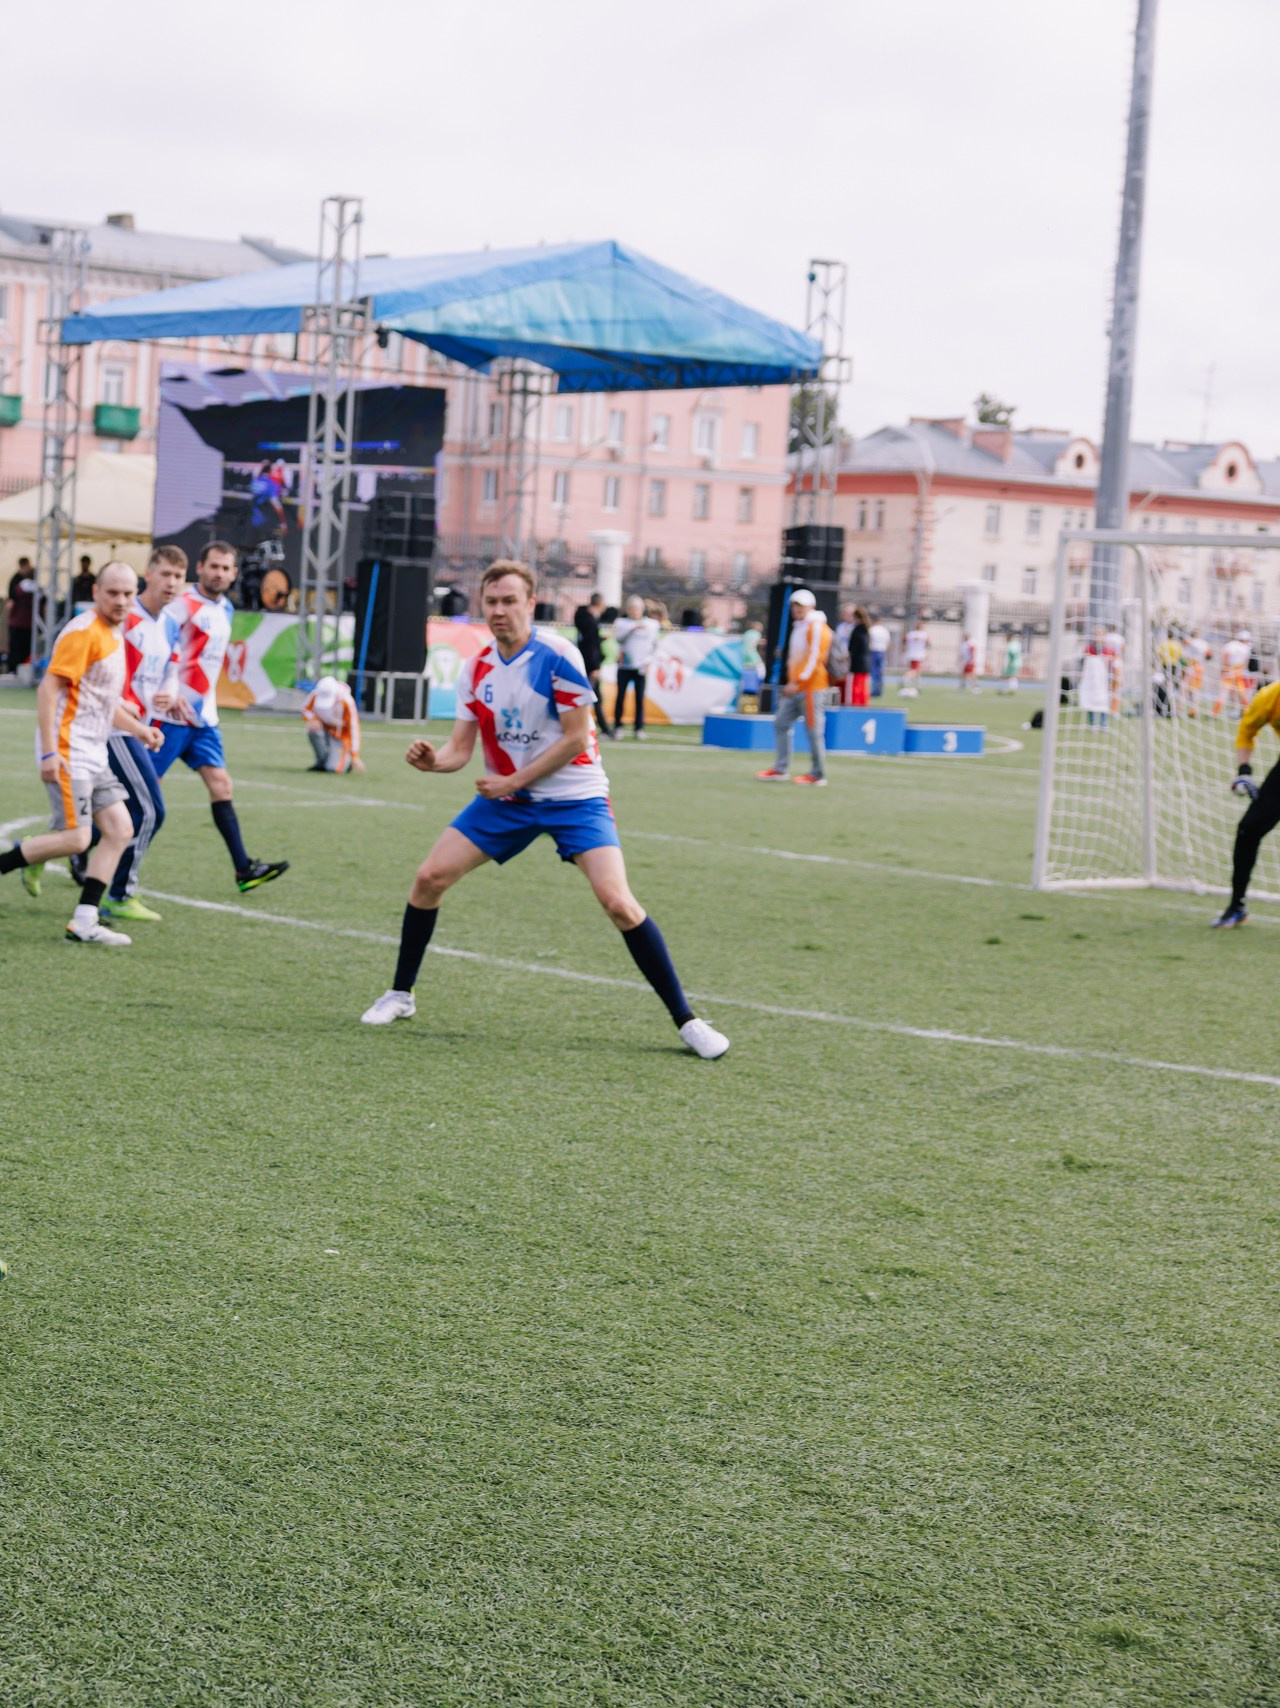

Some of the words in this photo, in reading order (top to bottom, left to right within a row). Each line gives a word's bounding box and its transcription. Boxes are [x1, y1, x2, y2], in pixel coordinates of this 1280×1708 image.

[484, 684, 493, 703] 6
[861, 718, 877, 745] 1
[942, 731, 959, 752] 3
[78, 797, 88, 816] 2
